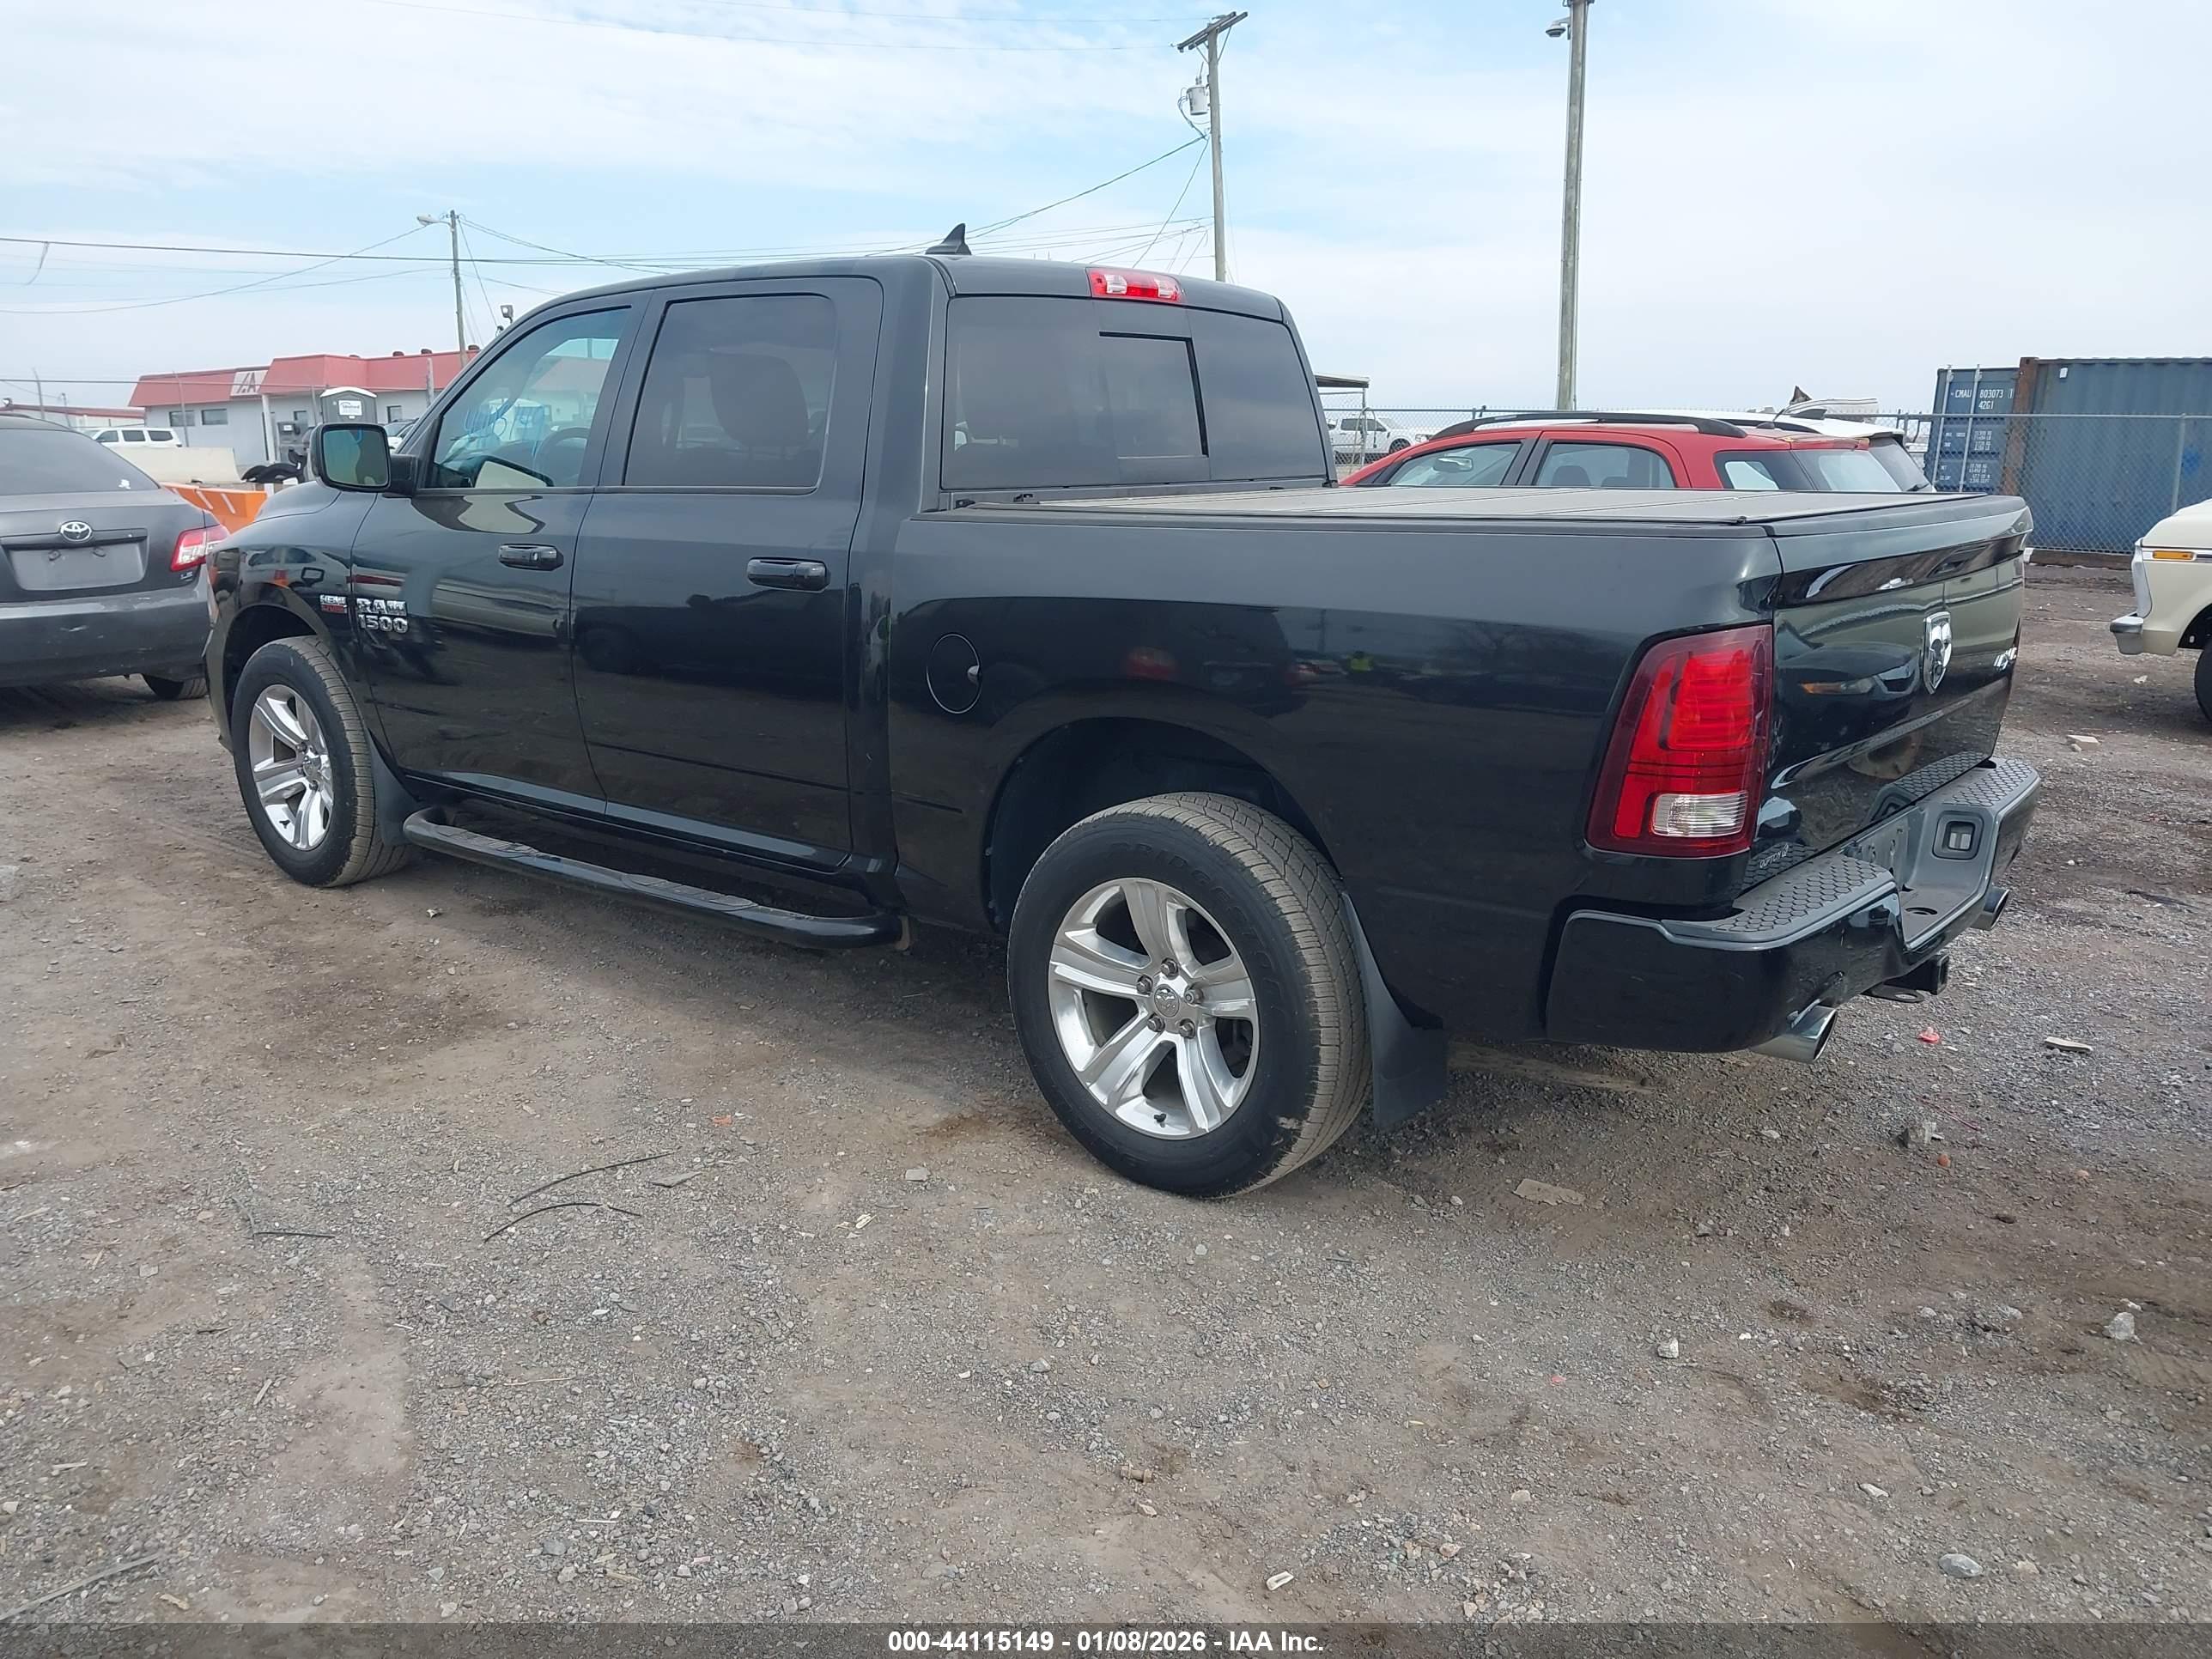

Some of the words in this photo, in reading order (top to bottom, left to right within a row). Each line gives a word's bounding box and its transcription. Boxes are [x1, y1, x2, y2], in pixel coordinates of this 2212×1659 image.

[1954, 389, 1972, 398] CMAU
[1979, 389, 2004, 398] 803073
[356, 598, 407, 617] RAM
[358, 614, 408, 634] 1500
